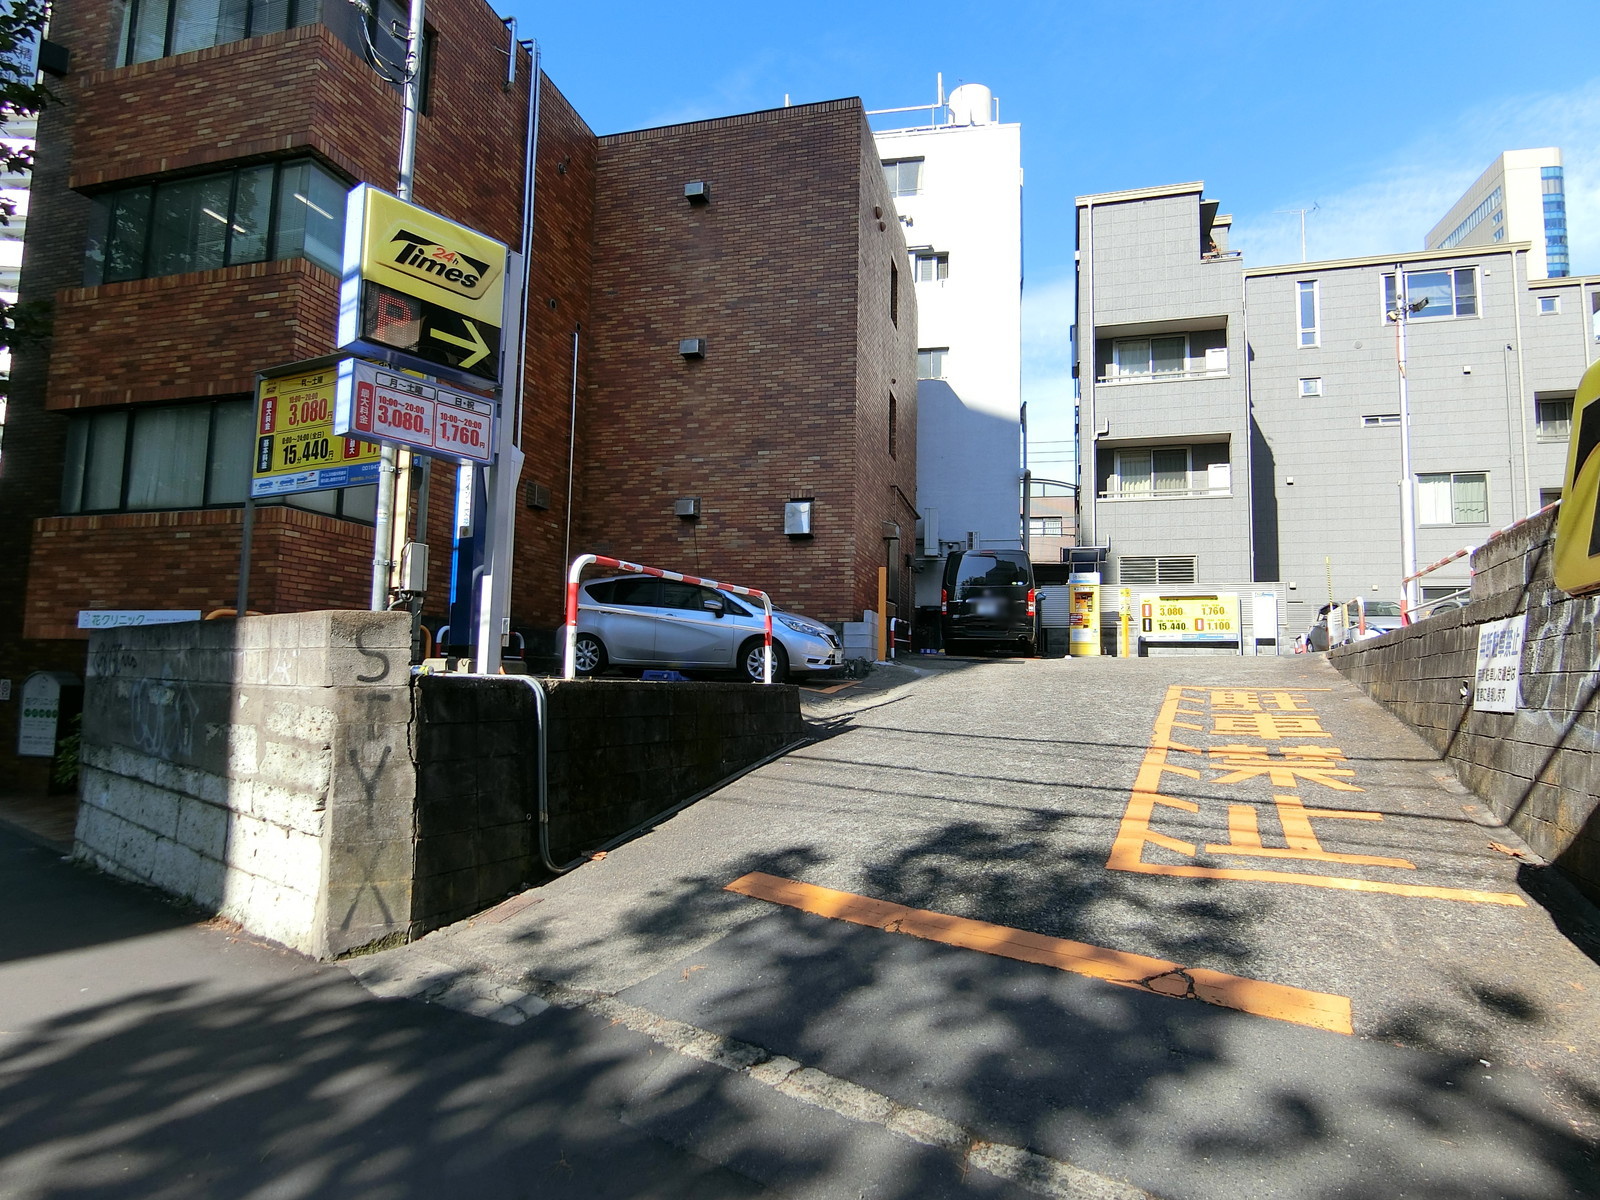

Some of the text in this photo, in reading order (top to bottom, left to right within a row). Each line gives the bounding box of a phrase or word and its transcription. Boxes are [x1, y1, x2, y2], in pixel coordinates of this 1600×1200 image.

[389, 229, 491, 289] Times
[432, 247, 459, 266] 24h
[377, 292, 412, 342] P
[360, 388, 370, 425] 最大料金
[92, 614, 145, 627] 花クリニック
[1479, 626, 1520, 659] 無断駐車禁止
[1205, 691, 1418, 871] 駐車禁止
